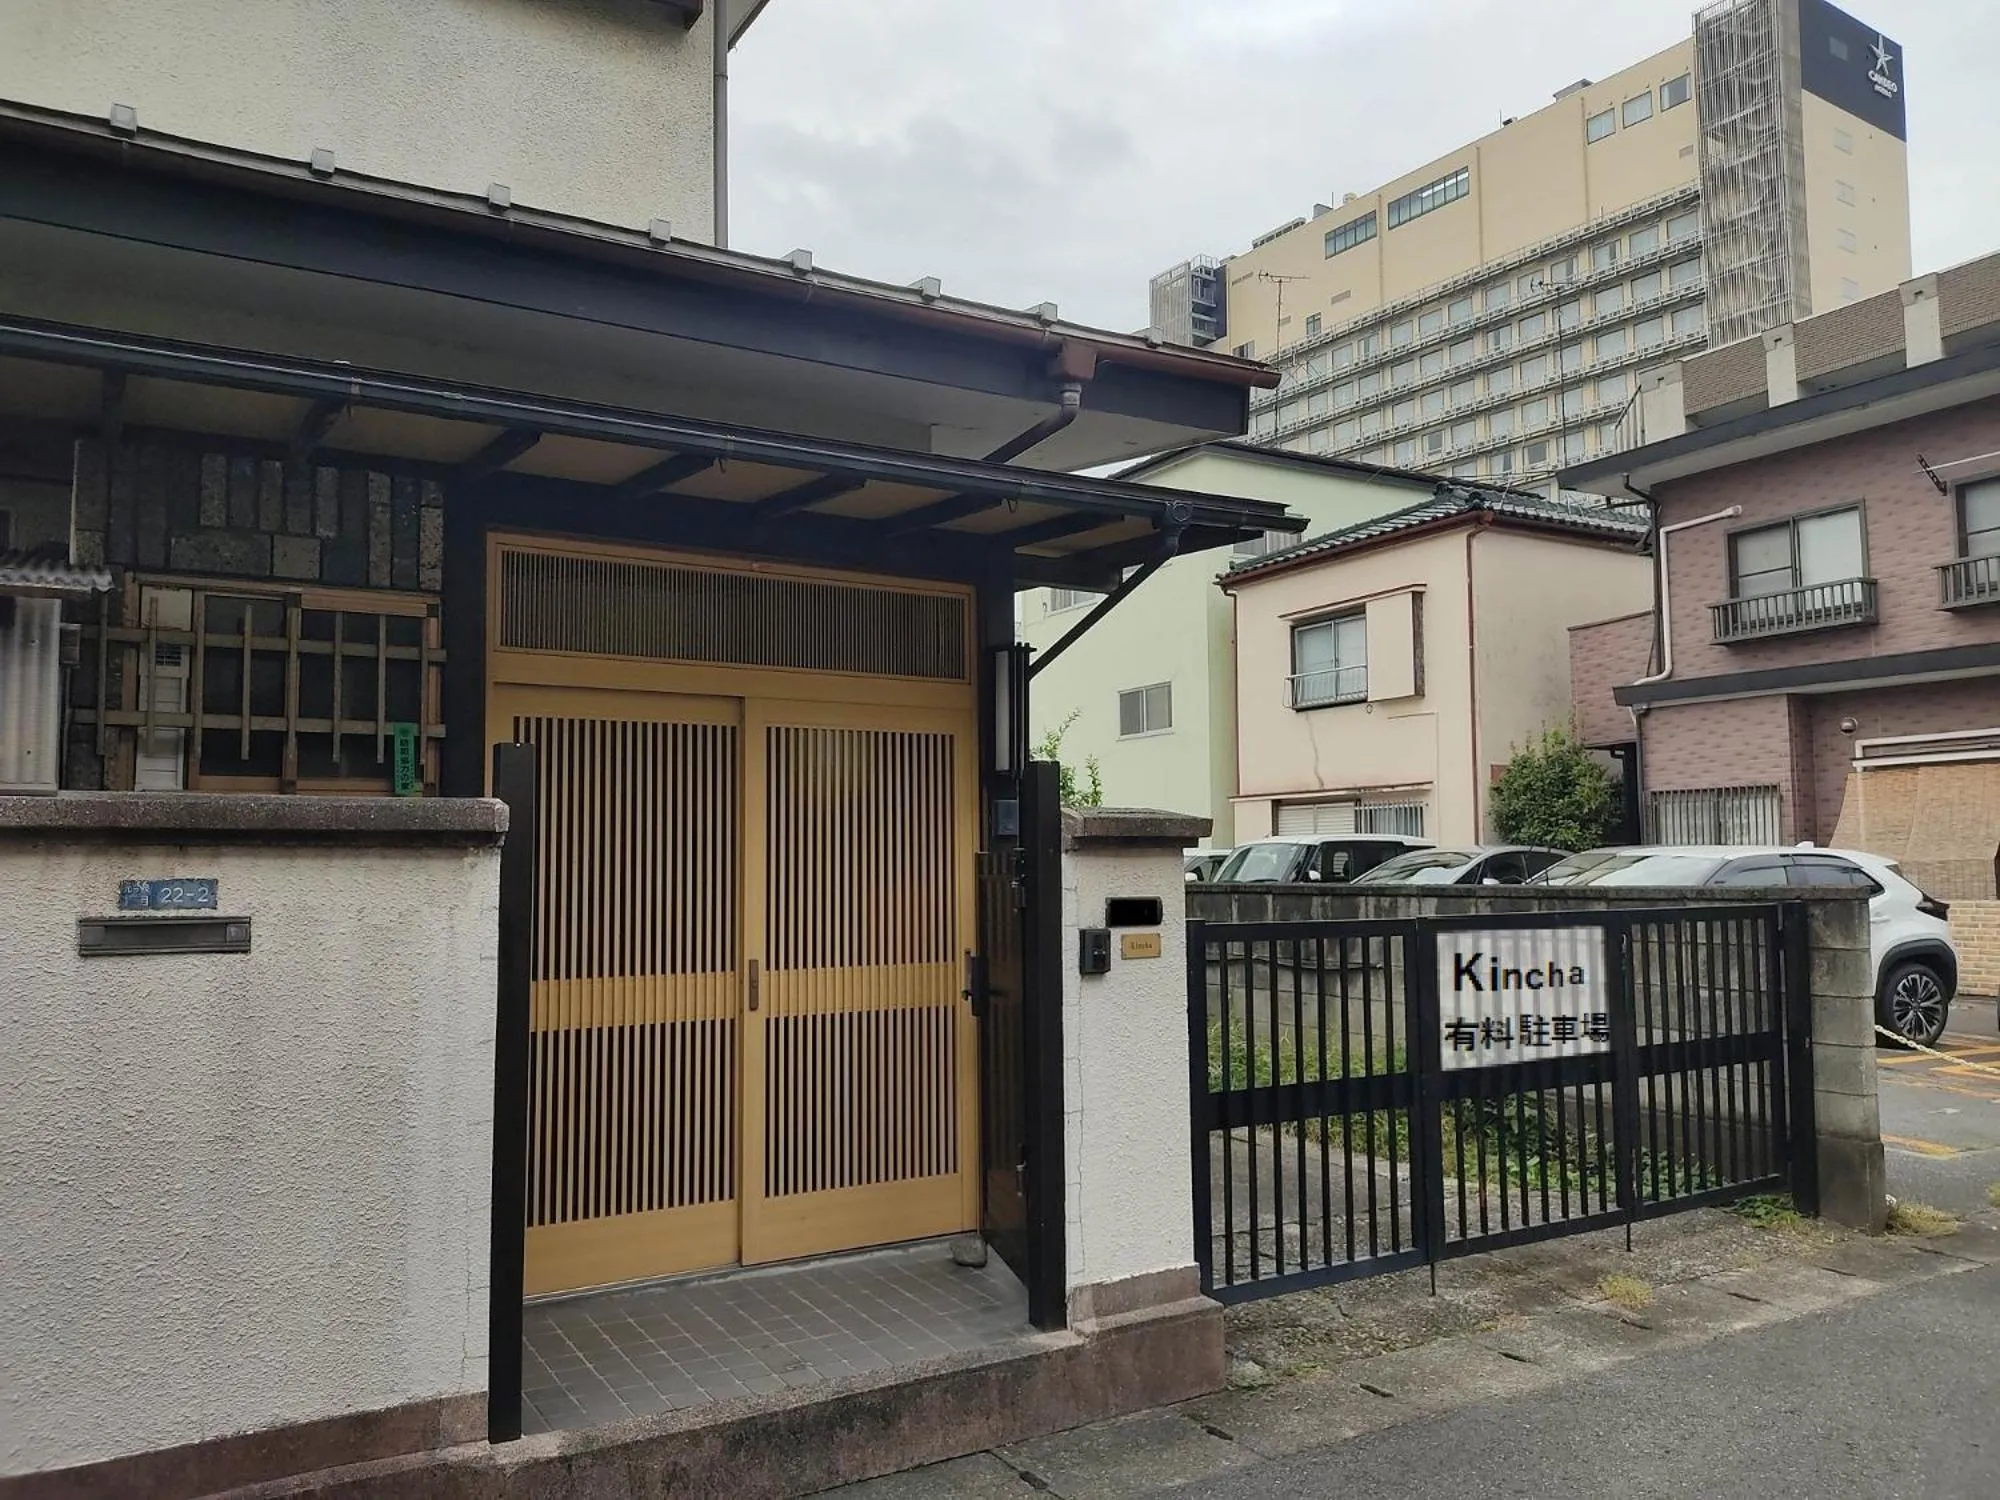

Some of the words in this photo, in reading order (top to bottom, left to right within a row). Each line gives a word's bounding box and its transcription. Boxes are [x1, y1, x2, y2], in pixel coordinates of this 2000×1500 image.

[160, 887, 209, 903] 22-2
[1454, 952, 1585, 992] Kincha
[1444, 1012, 1610, 1051] 有料駐車場
